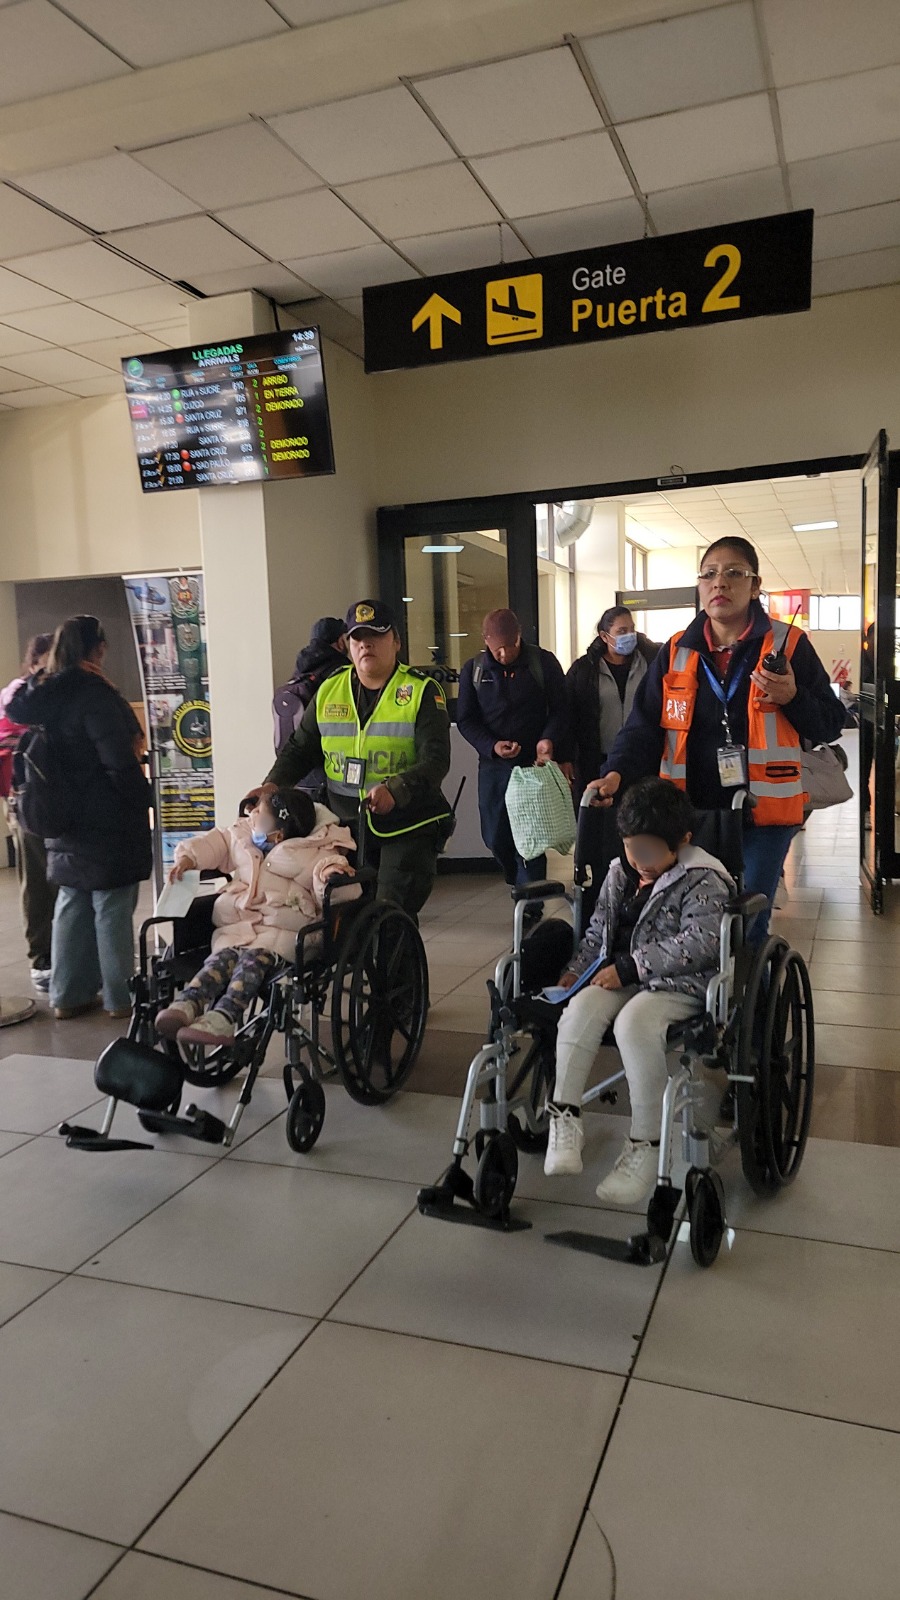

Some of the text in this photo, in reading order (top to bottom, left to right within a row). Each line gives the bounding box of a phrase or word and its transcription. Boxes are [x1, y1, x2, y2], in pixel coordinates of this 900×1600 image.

[571, 263, 627, 291] Gate
[571, 243, 742, 333] Puerta 2
[192, 343, 243, 360] LLEGADAS
[197, 353, 240, 367] ARRIVALS
[199, 384, 220, 394] SUCRE
[252, 378, 257, 386] 2
[262, 374, 287, 385] ARRIBO
[263, 389, 274, 398] EN
[275, 385, 298, 397] TIERRA
[184, 412, 204, 422] SANTA
[204, 409, 222, 419] CRUZ
[255, 404, 261, 413] 2
[265, 398, 304, 411] DEMORADO
[257, 417, 262, 425] 2
[198, 435, 219, 444] SANTA
[258, 429, 264, 437] 2
[189, 448, 210, 458] SANTA
[210, 446, 227, 455] CRUZ
[260, 441, 265, 450] 2
[270, 436, 308, 448] DEMORADO
[210, 458, 230, 467] PAULO
[271, 449, 309, 461] DEMORADO
[196, 472, 216, 481] SANTA
